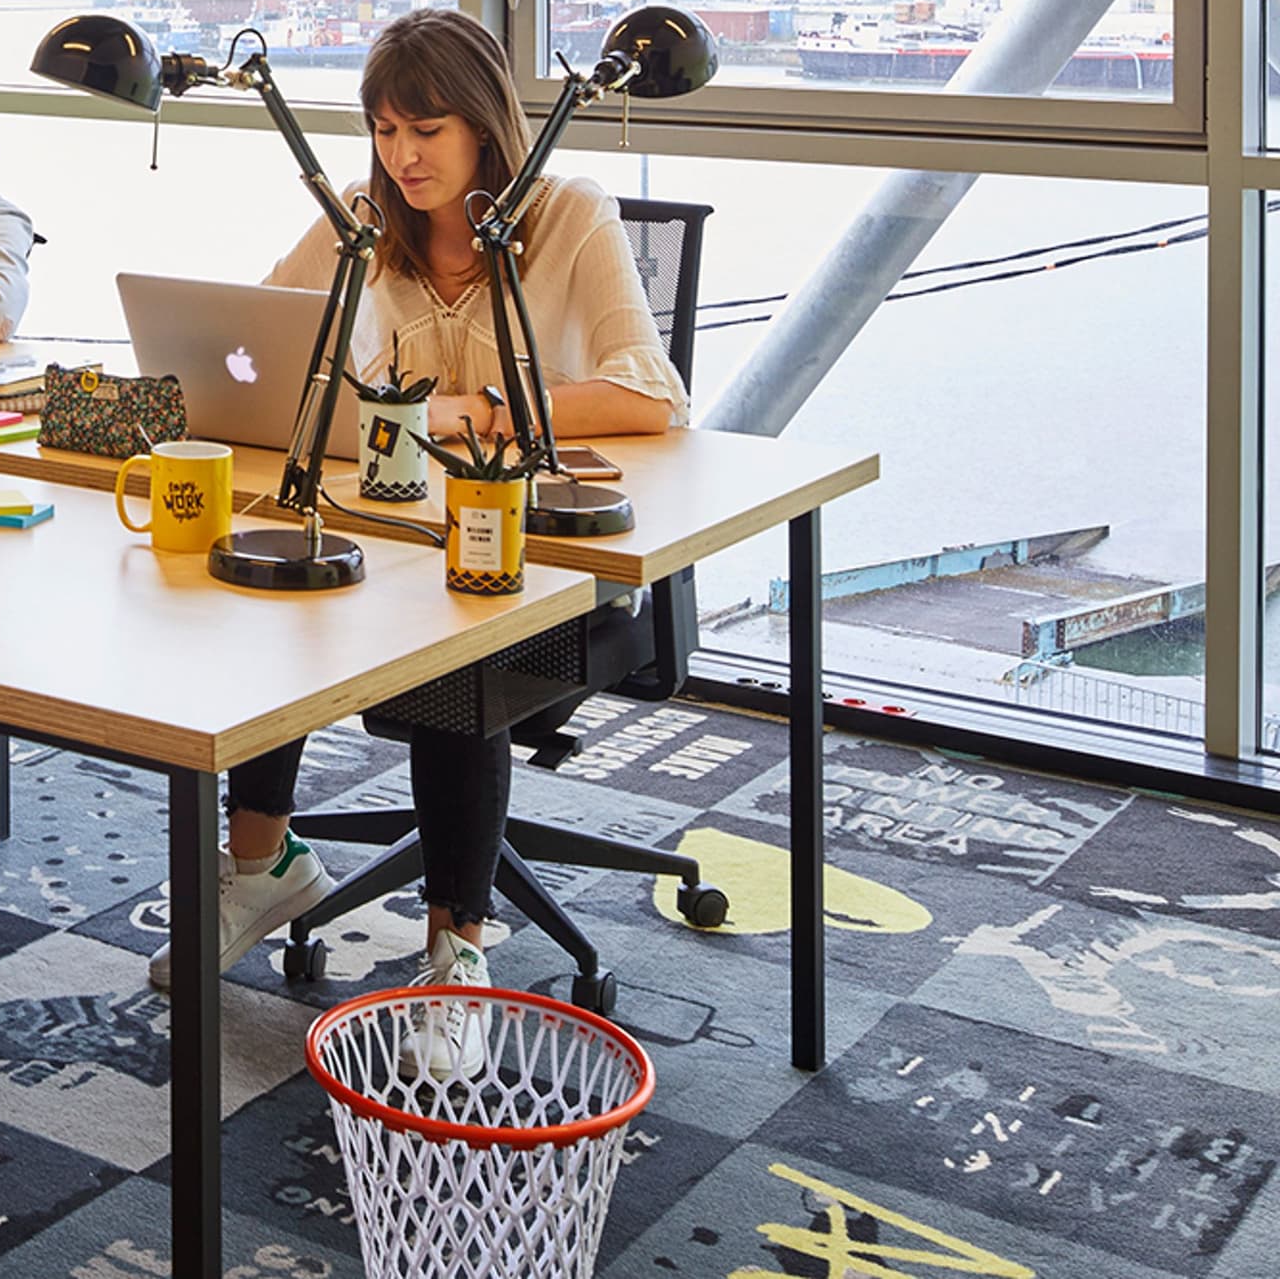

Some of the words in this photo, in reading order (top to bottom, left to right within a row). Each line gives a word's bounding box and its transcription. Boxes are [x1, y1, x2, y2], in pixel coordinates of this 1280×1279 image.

[163, 493, 204, 510] WORK
[555, 708, 708, 780] BUSINESS
[648, 734, 753, 780] MAKE
[834, 769, 1051, 821] POWER
[916, 764, 1005, 790] NO
[824, 784, 1064, 845] OINTING
